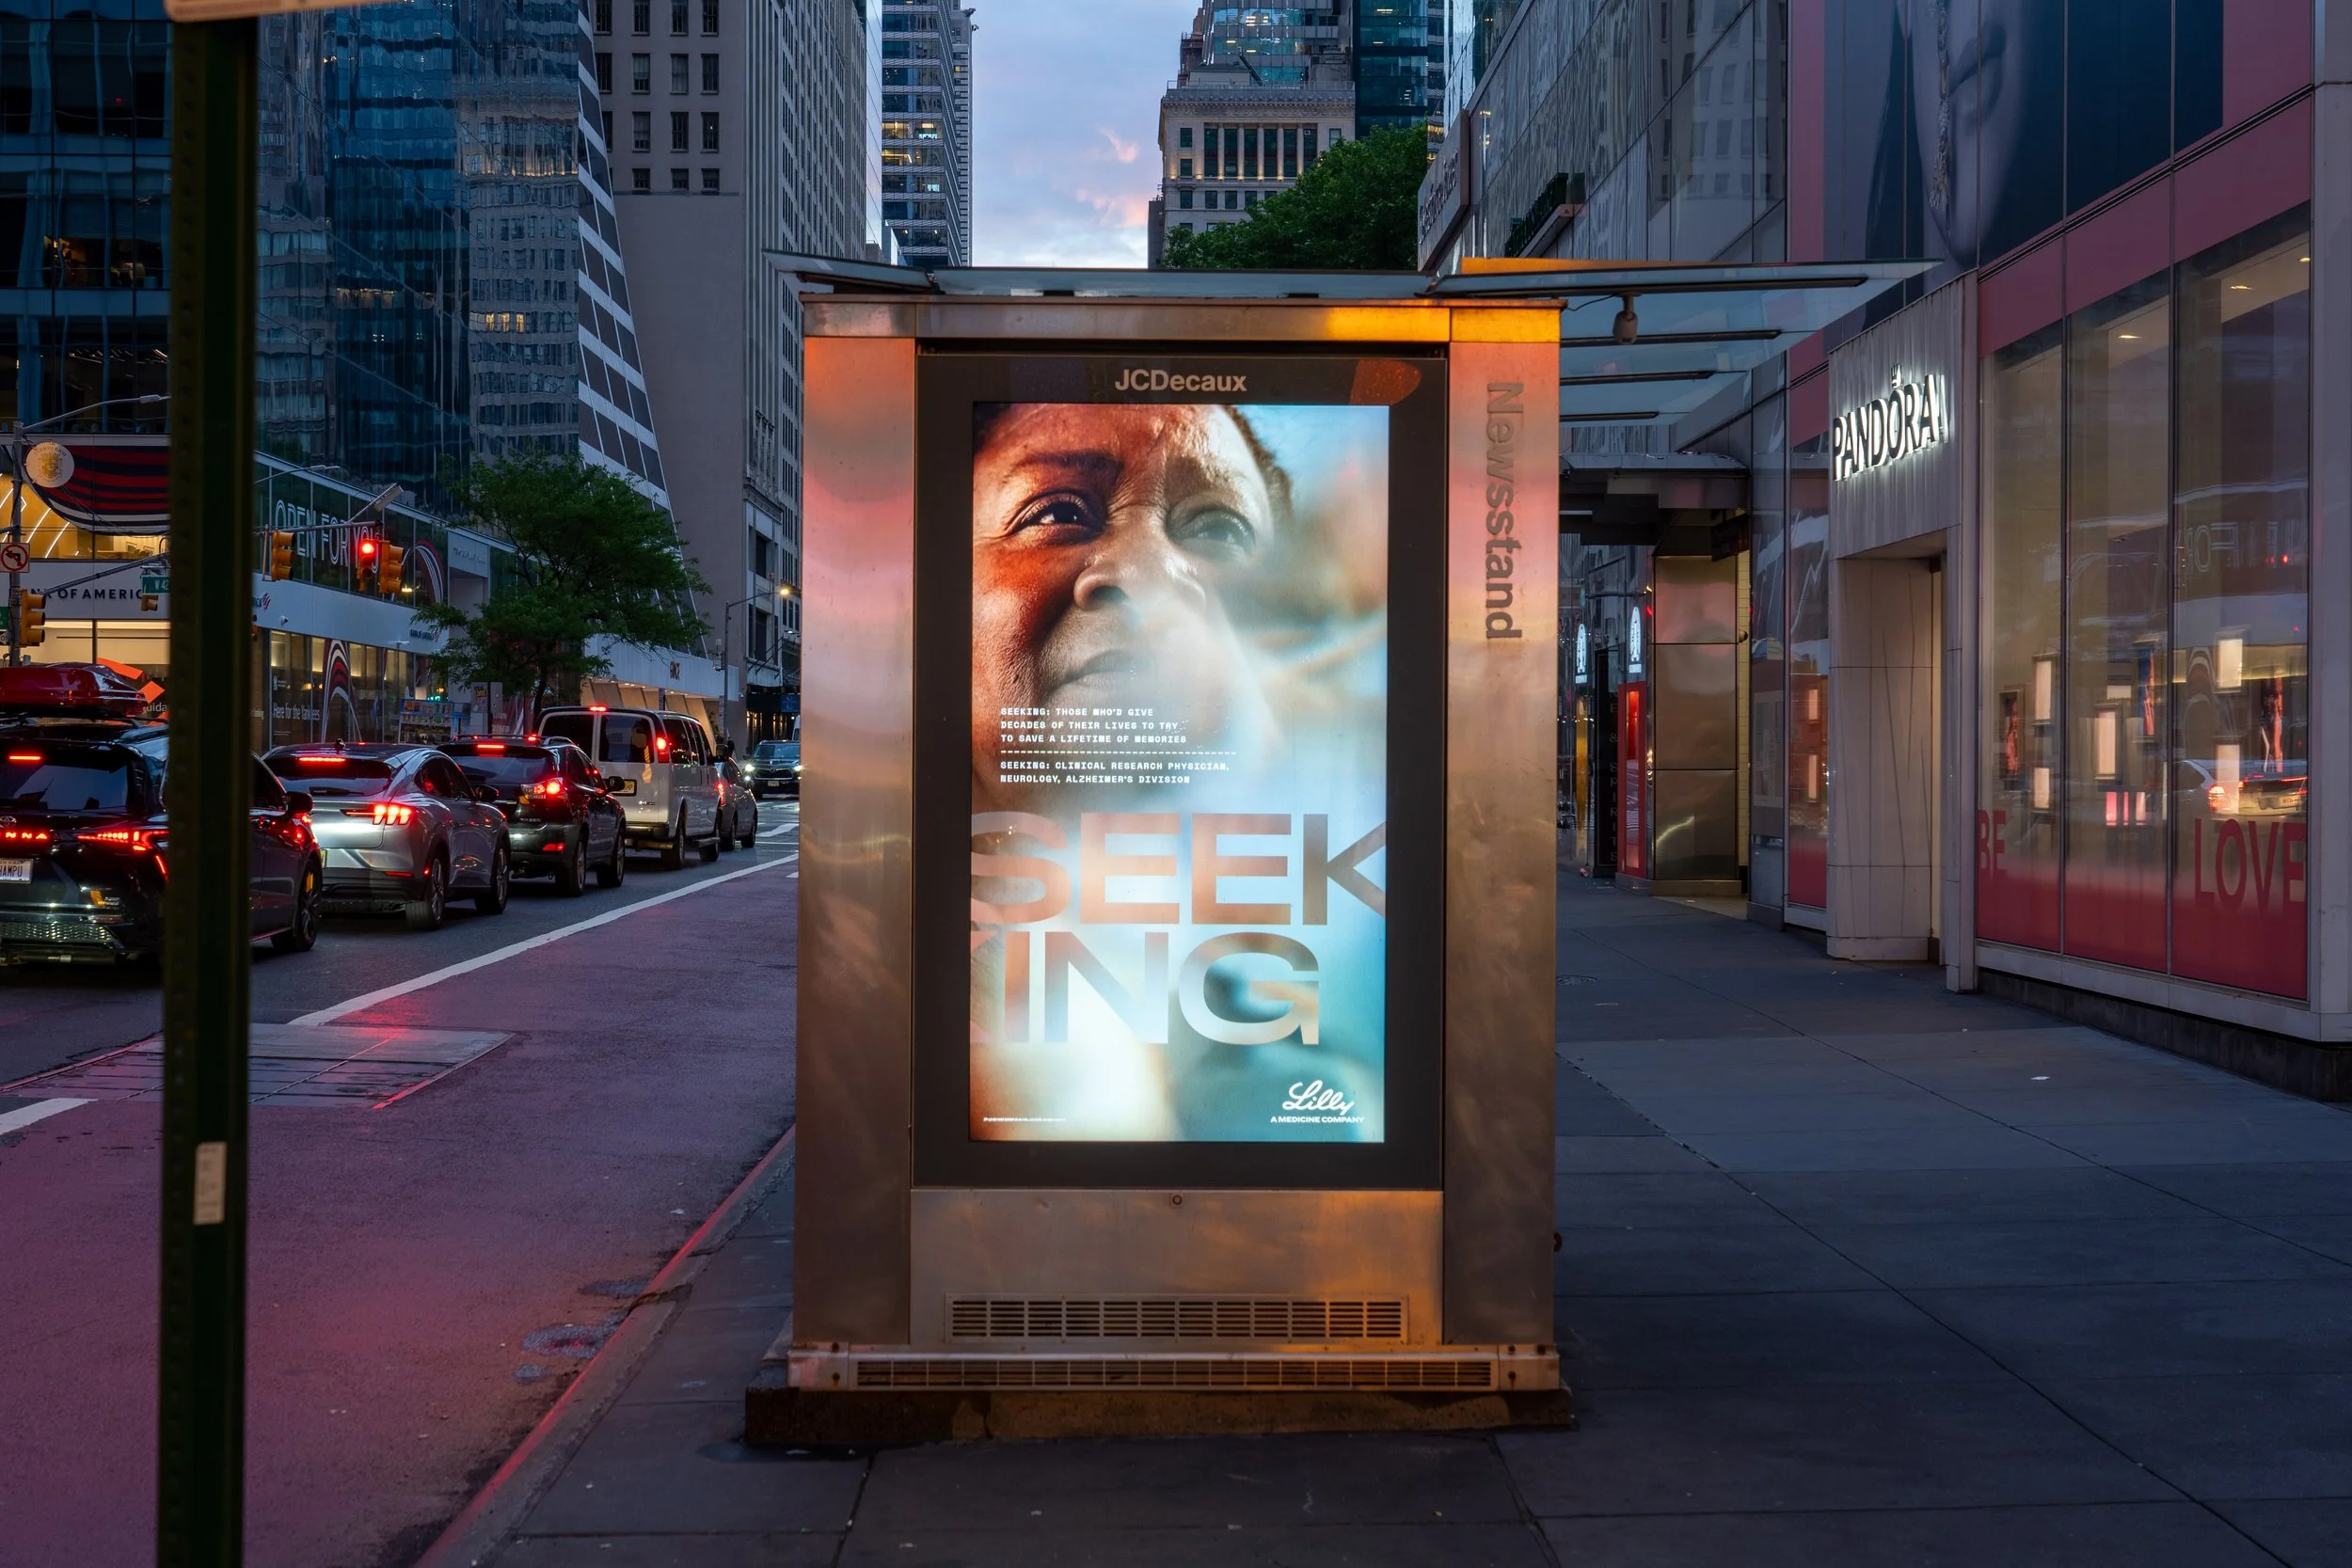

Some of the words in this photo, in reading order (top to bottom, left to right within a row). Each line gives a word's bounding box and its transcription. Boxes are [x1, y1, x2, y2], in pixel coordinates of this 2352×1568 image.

[1115, 369, 1248, 392] JCDecaux
[1833, 373, 1939, 482] PANDORA
[1486, 383, 1524, 639] Newsstand
[275, 499, 316, 559] OPEN
[321, 513, 348, 567] FOR
[57, 588, 77, 599] OF
[82, 588, 142, 599] AMERIC
[154, 579, 160, 591] W
[1001, 707, 1051, 716] SEEKING:
[1056, 707, 1088, 716] THOSE
[1092, 707, 1122, 716] WHO'D
[1128, 707, 1153, 716] GIVE
[1001, 721, 1046, 729] DECADES
[1051, 721, 1064, 729] OF
[1069, 721, 1100, 729] THEIR
[1105, 721, 1137, 730] LIVES
[1142, 721, 1154, 730] TO
[1159, 721, 1179, 730] TRY
[1060, 735, 1111, 743] LIFETIME
[1117, 735, 1129, 743] OF
[1135, 735, 1186, 743] MEMORIES
[1000, 761, 1051, 769] SEEKING:
[1055, 761, 1105, 769] CLINICAL
[1111, 761, 1163, 769] RESEARCH
[1168, 762, 1230, 771] PHYSICIAN,
[1000, 774, 1061, 784] NEUROLOGY,
[1066, 774, 1133, 784] ALZHEIMER'S
[1138, 775, 1189, 784] DIVISION
[1978, 809, 2006, 882] BE
[971, 811, 1386, 926] SEEK
[2195, 818, 2306, 918] LOVE
[1004, 930, 1319, 1046] ING
[1282, 1080, 1355, 1117] Lilly
